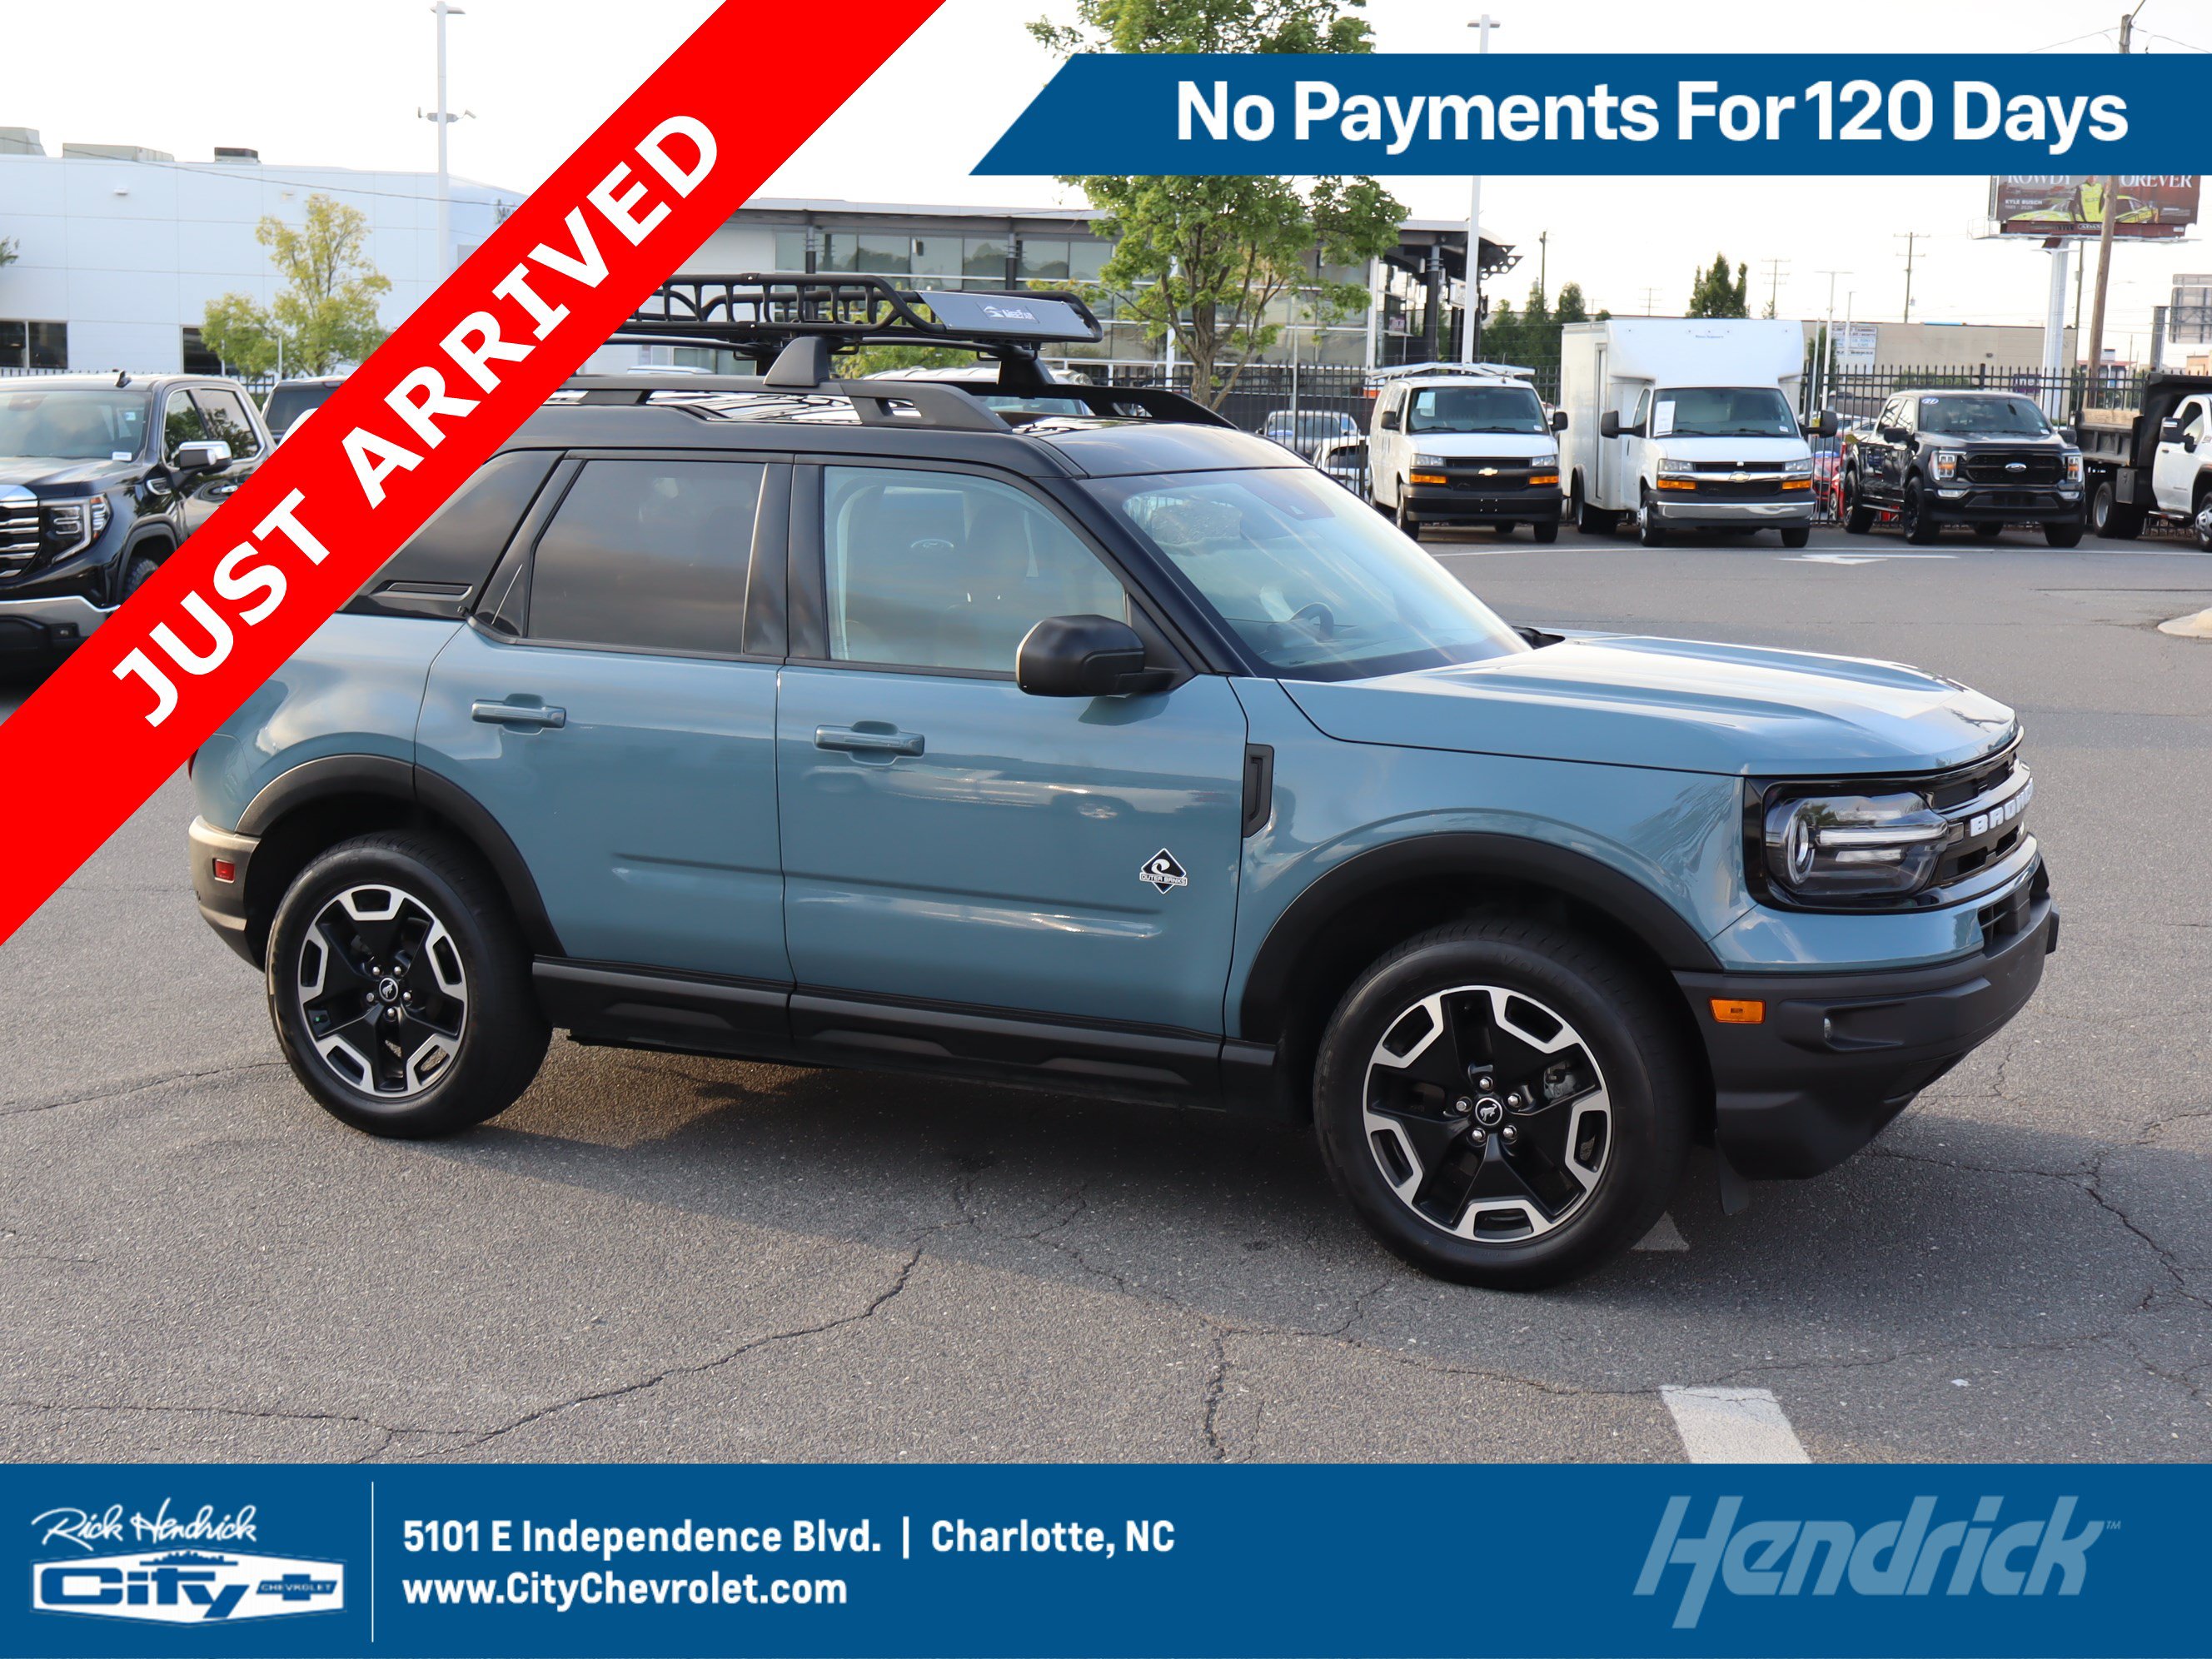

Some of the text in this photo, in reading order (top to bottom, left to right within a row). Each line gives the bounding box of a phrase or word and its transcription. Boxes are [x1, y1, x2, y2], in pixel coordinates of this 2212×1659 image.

[2118, 175, 2193, 188] OREVER
[1970, 777, 2034, 837] BRONC
[1141, 874, 1186, 884] OUTER BANKS
